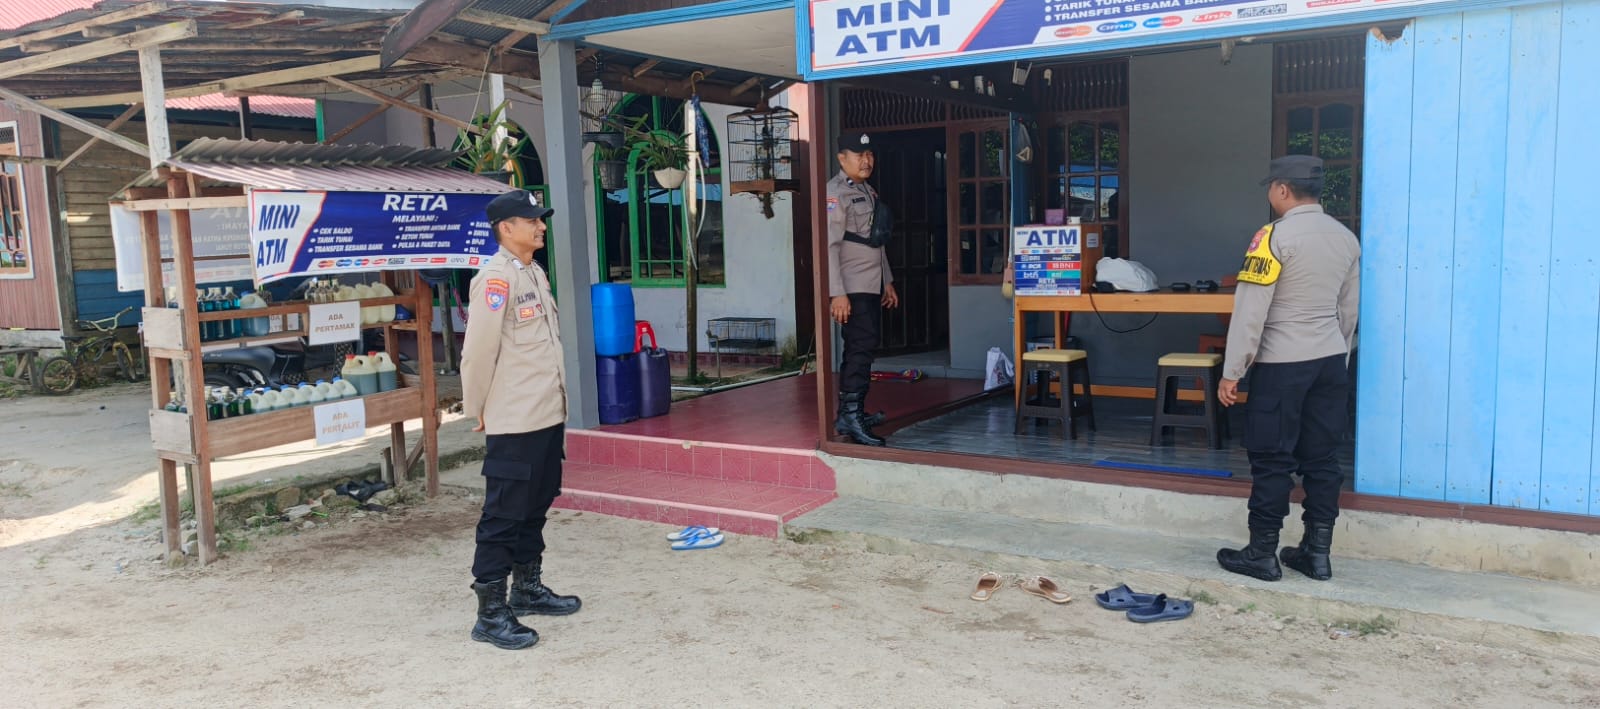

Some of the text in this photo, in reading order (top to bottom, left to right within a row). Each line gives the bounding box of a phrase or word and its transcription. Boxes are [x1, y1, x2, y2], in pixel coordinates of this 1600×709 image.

[836, 0, 950, 29] MINI
[1053, 0, 1092, 12] TARIK
[1054, 6, 1121, 21] TRANSFER
[1124, 0, 1180, 13] SESAMA
[835, 24, 940, 57] ATM
[382, 194, 448, 211] RETA
[259, 204, 300, 231] MINI
[1026, 229, 1077, 246] ATM
[257, 238, 288, 268] ATM
[328, 313, 344, 321] ADA
